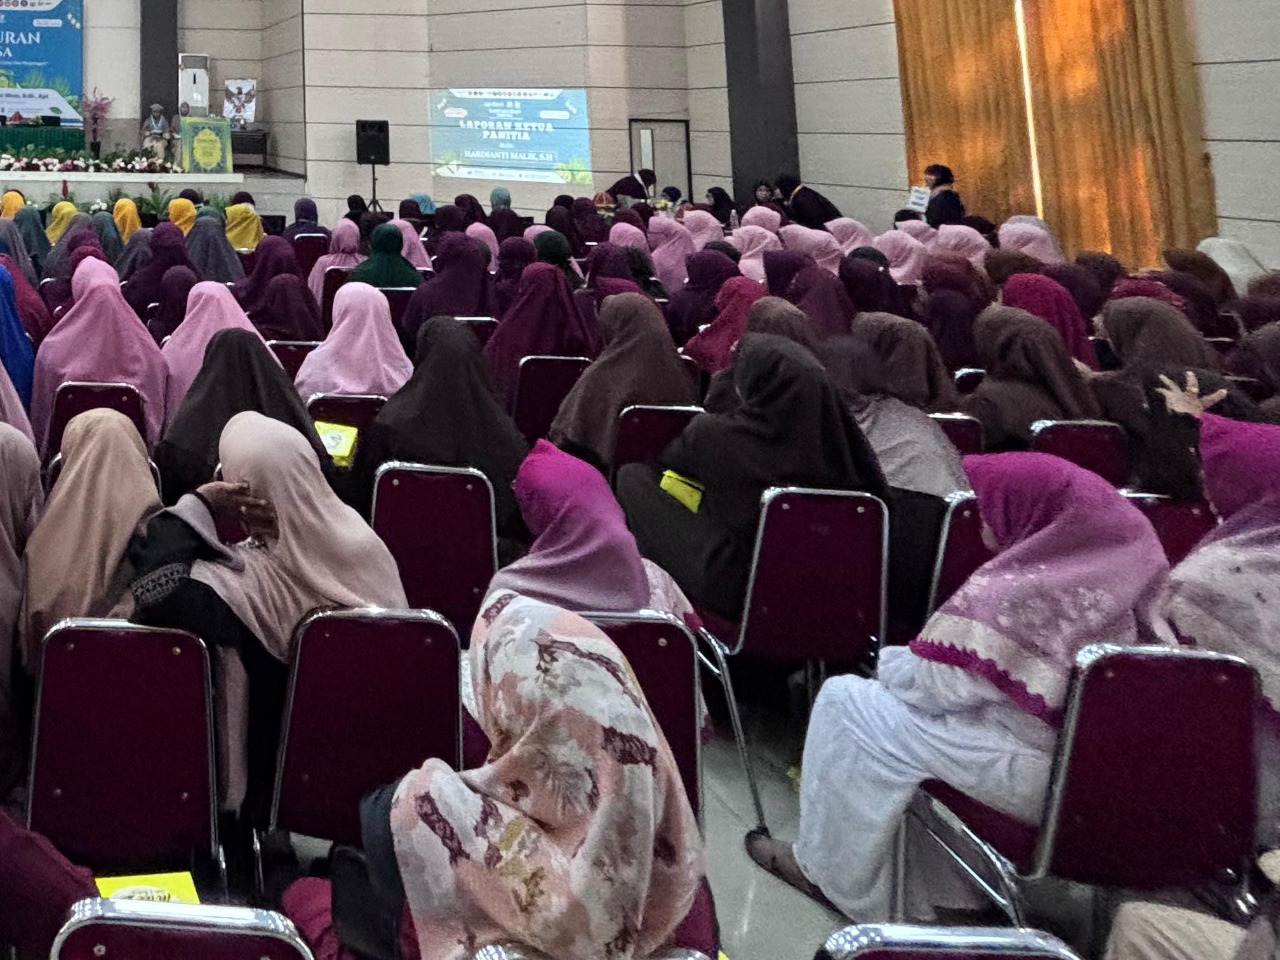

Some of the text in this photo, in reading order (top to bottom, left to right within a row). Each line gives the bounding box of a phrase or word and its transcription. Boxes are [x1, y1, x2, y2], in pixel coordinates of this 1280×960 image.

[459, 120, 555, 132] LAPORAN KETUA
[483, 130, 531, 141] PANITIA
[464, 150, 510, 160] HARDIANTI
